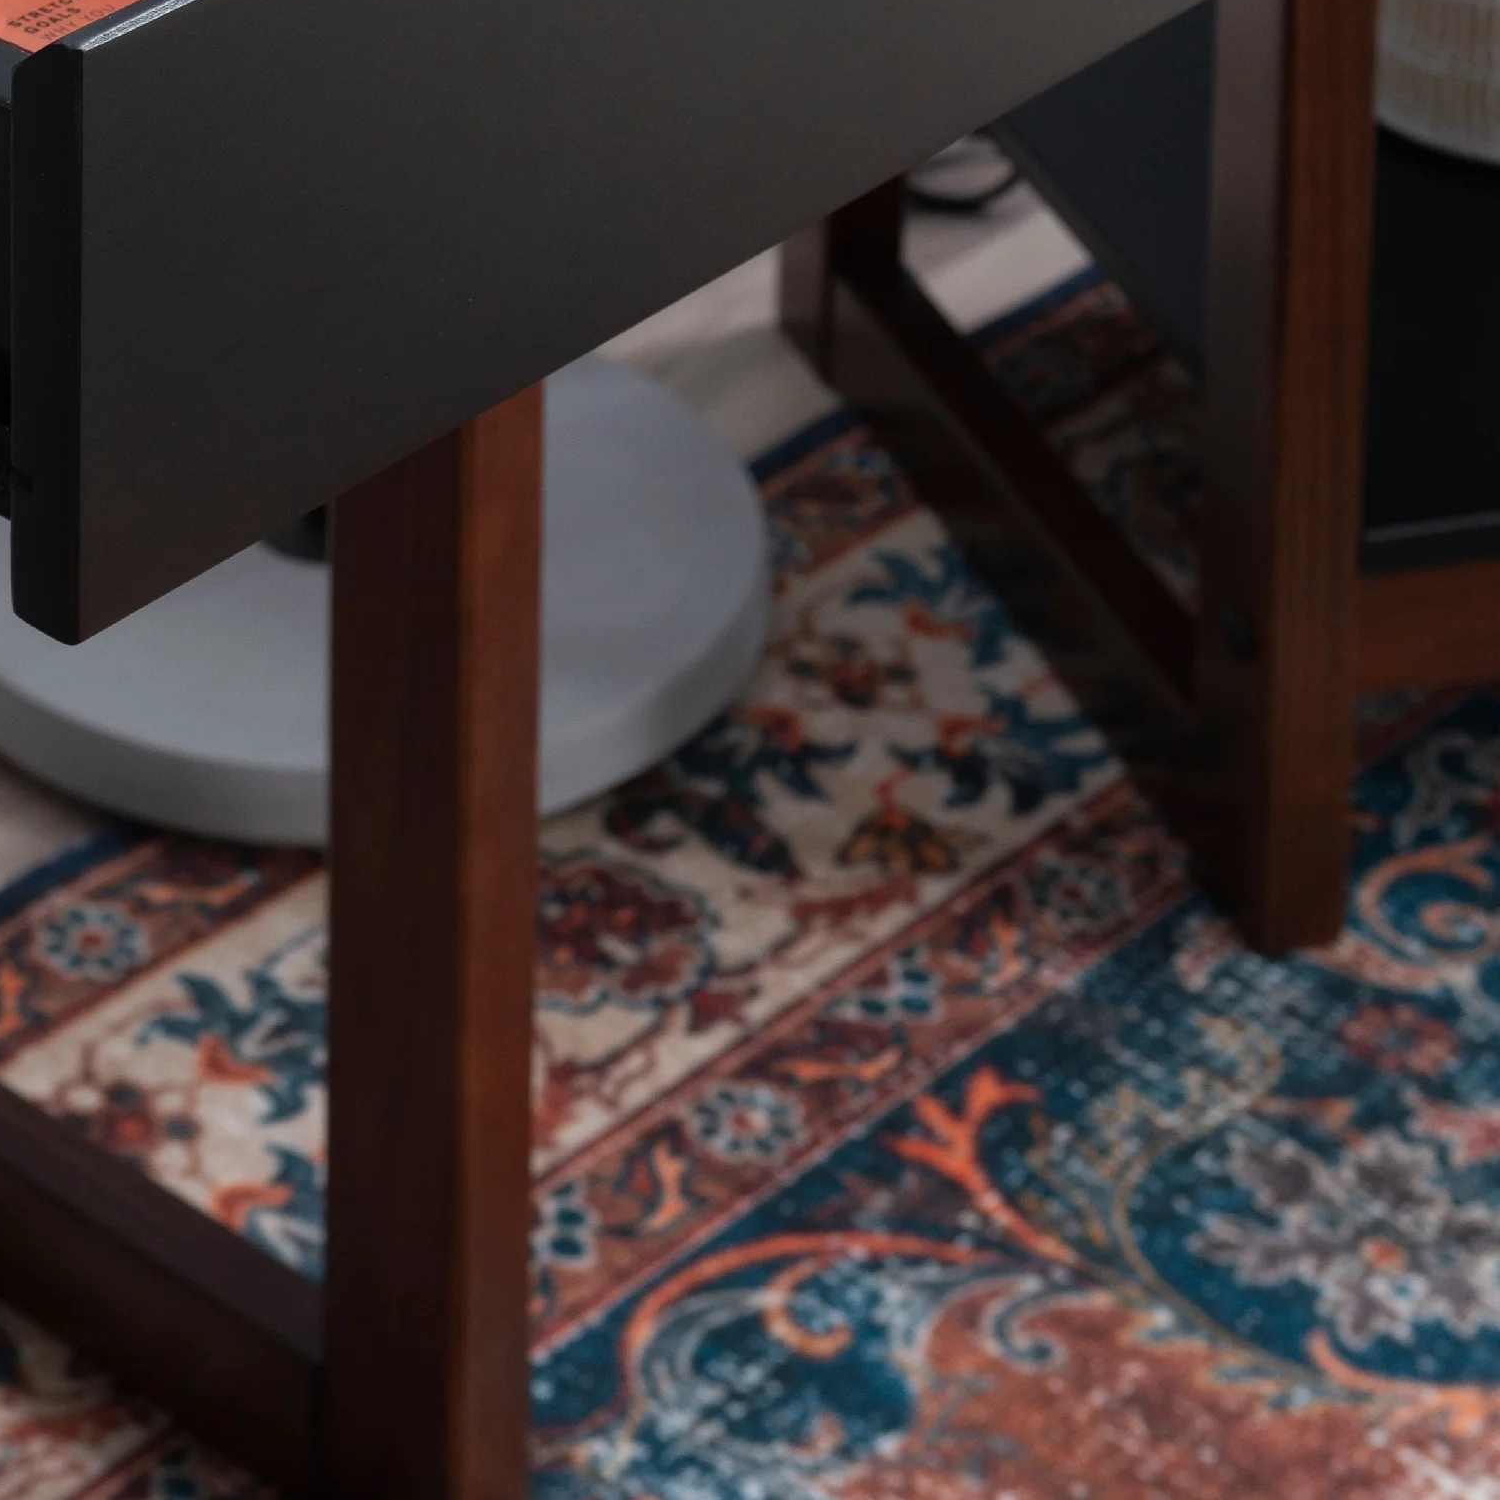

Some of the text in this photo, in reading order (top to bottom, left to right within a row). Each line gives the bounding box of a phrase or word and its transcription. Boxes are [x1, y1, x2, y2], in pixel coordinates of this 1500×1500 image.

[23, 6, 82, 34] GOALS
[40, 3, 116, 40] WHY YOU
